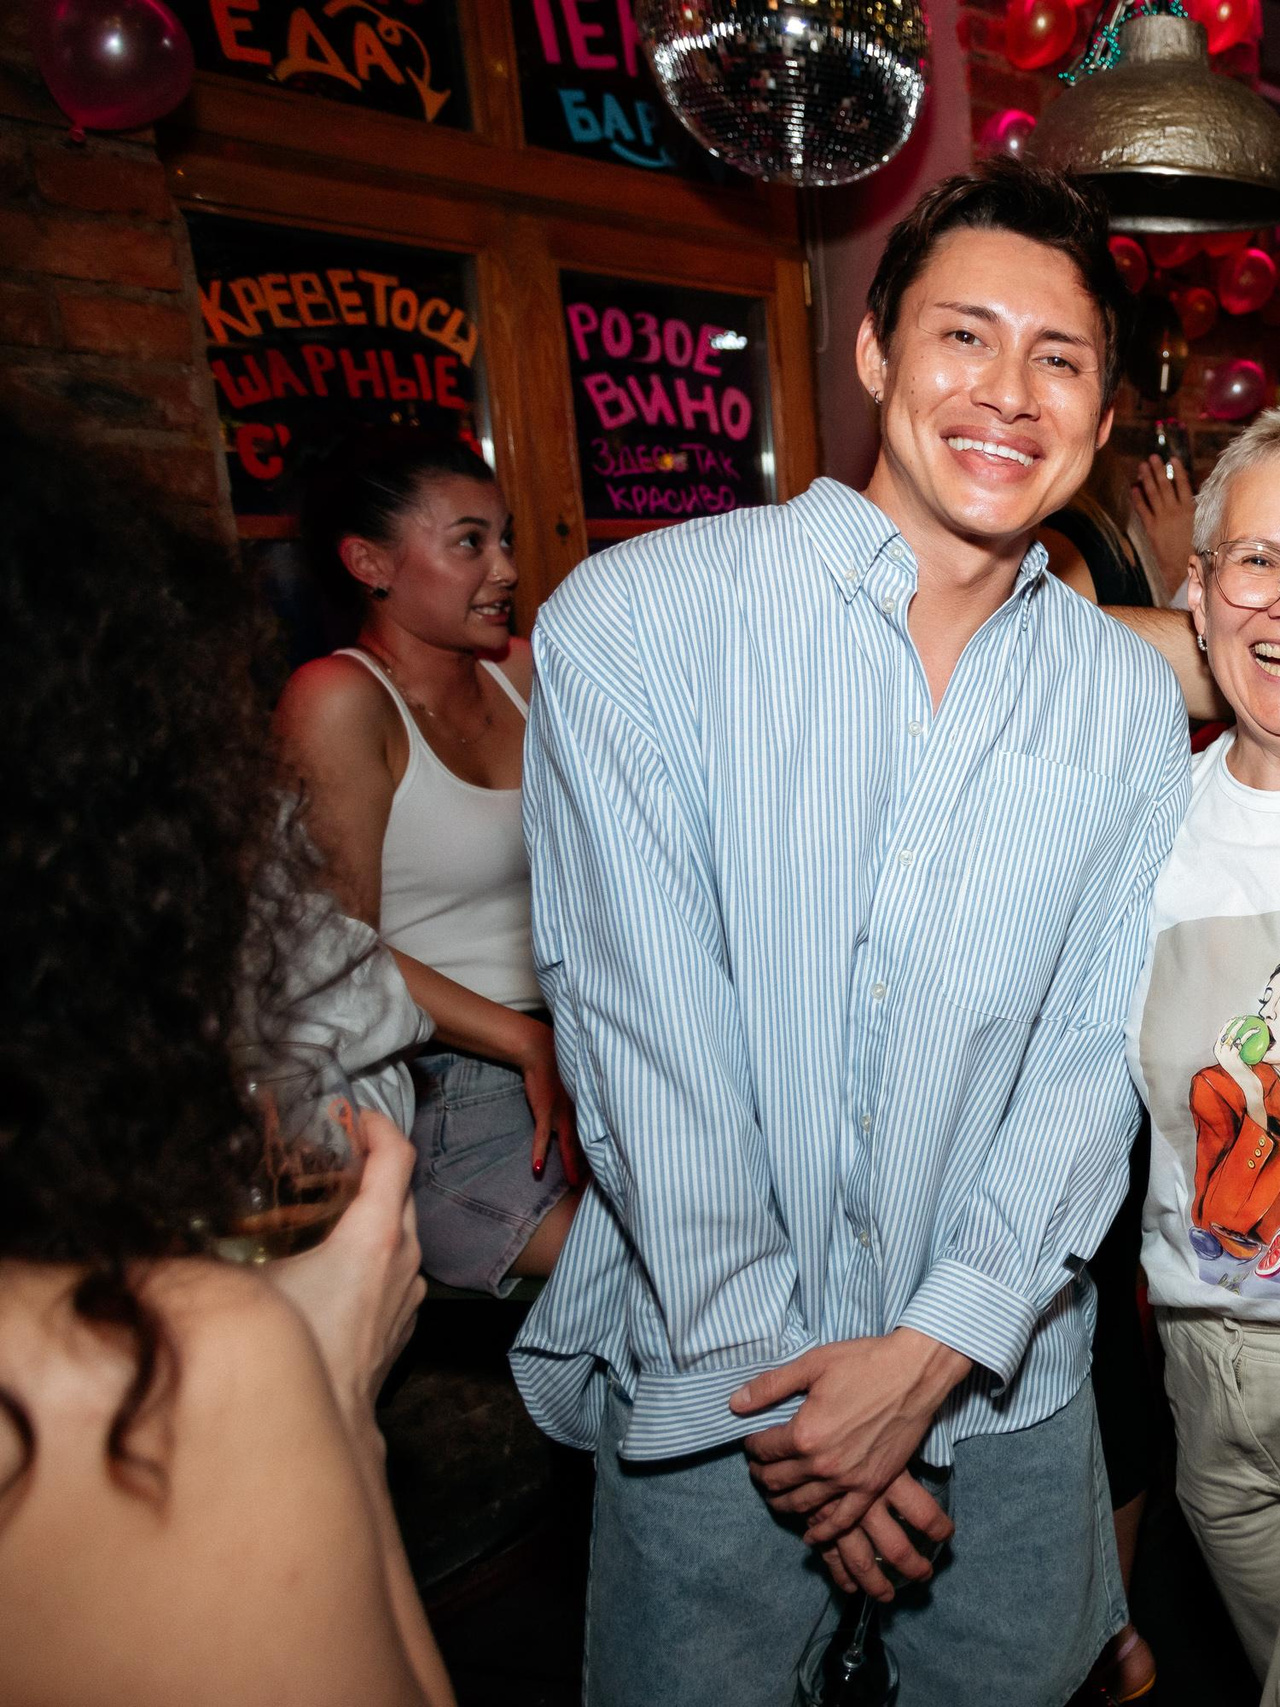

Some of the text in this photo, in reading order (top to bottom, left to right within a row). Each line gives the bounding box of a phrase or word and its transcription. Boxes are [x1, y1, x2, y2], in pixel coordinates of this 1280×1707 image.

[207, 0, 407, 91] ЕДА
[565, 301, 727, 378] РОЗОЕ
[581, 371, 752, 442] ВИНО
[678, 442, 742, 482] ТАК
[604, 481, 737, 516] КРАСИВО
